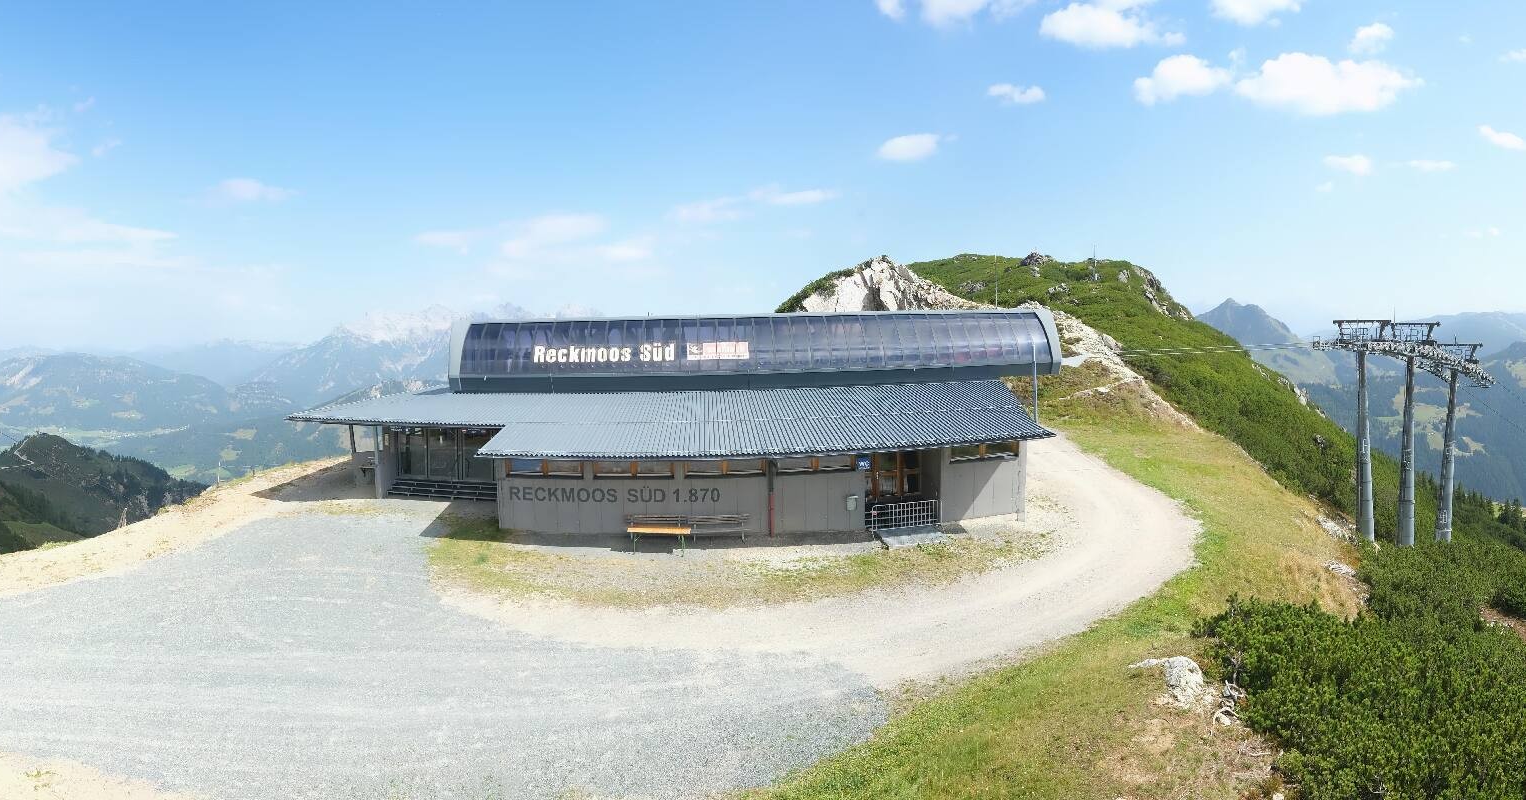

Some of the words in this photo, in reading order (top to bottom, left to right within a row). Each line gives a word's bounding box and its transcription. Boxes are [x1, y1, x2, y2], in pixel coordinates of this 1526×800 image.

[533, 345, 631, 363] Reckmoos
[640, 342, 675, 361] Süd
[508, 486, 618, 502] RECKMOOS
[627, 486, 667, 503] SÜD
[672, 487, 721, 503] 1.870
